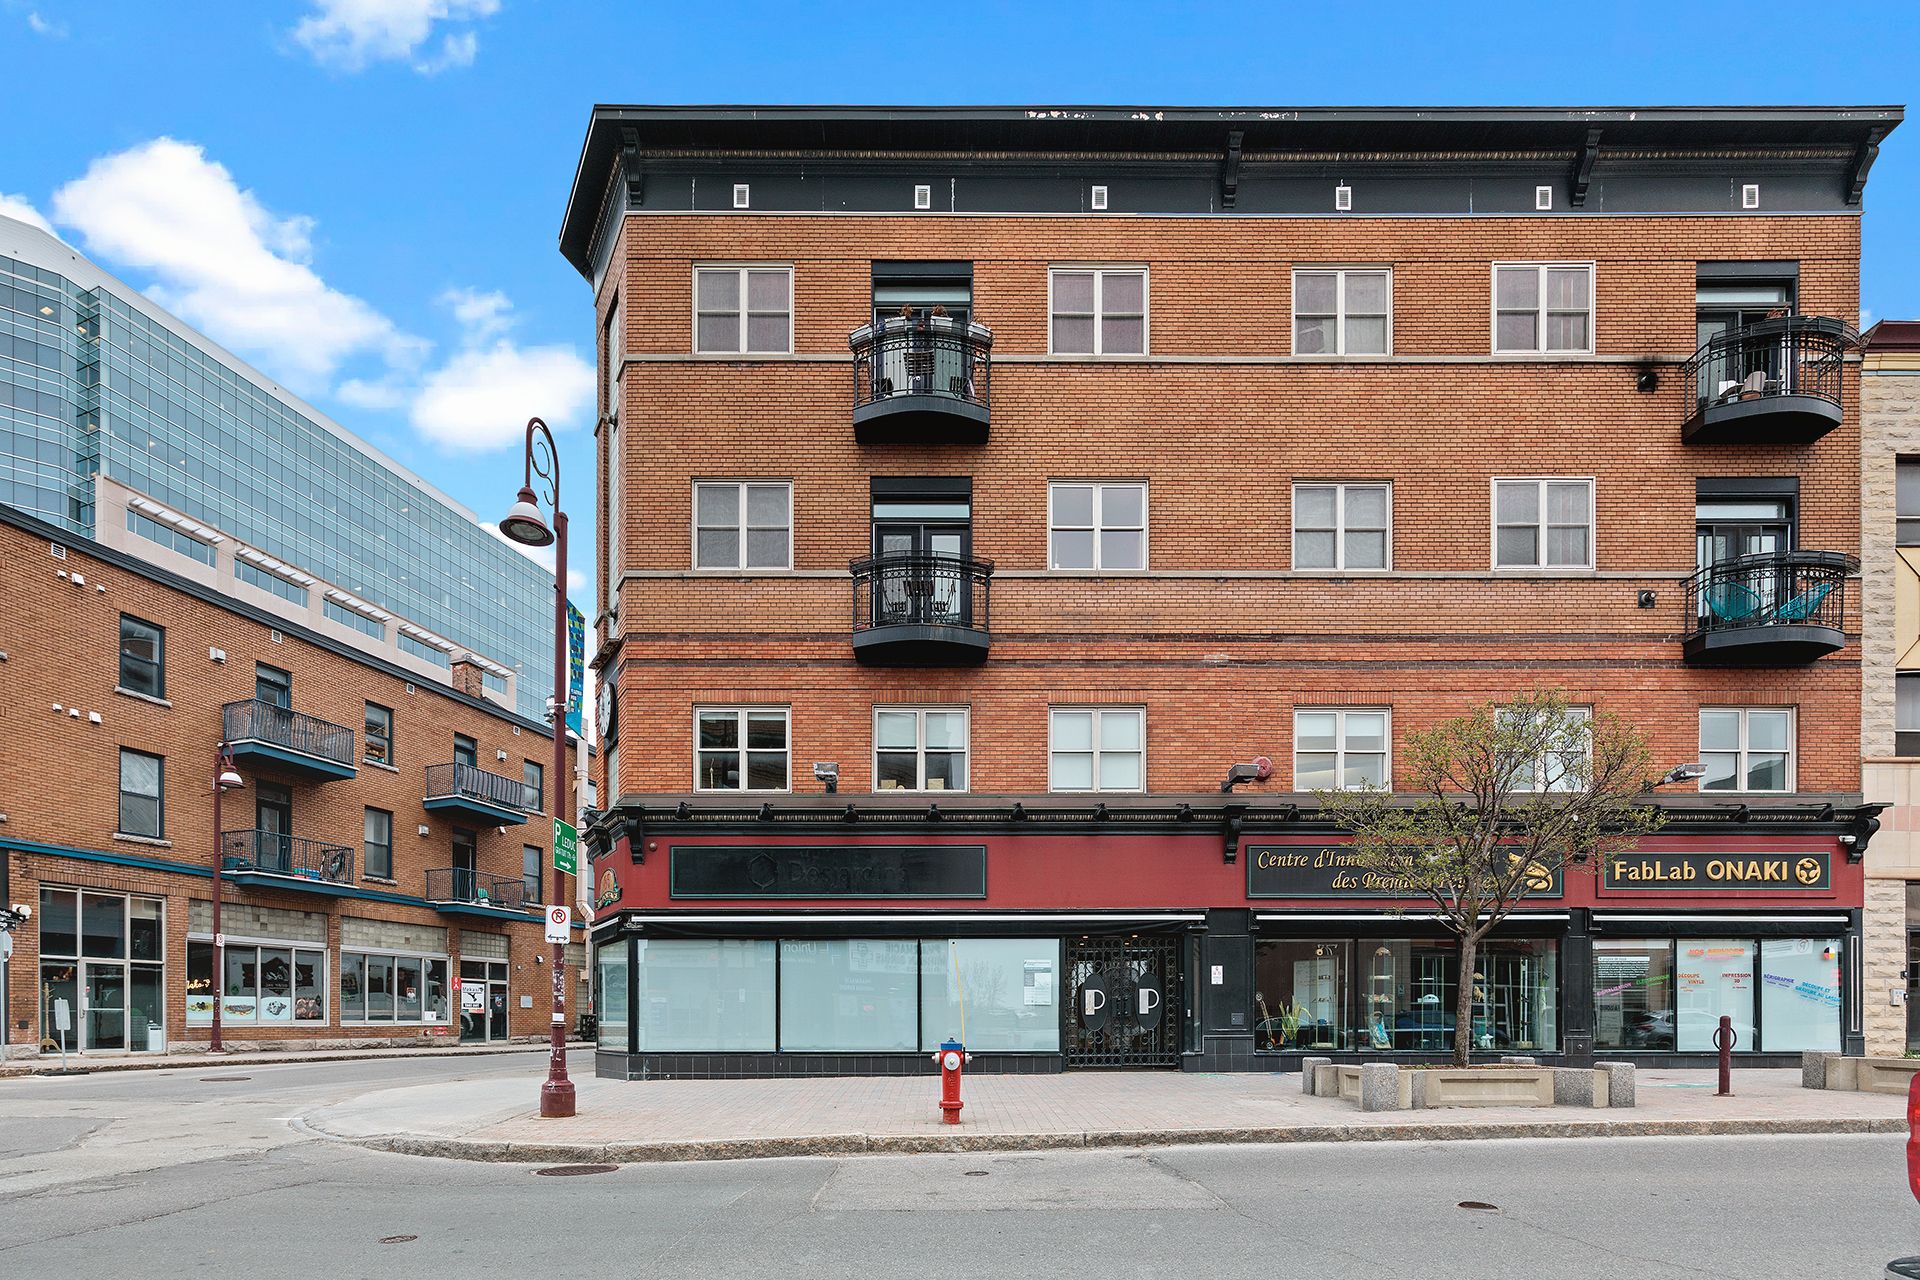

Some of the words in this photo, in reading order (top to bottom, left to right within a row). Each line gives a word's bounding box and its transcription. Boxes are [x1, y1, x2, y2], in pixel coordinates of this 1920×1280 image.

[555, 823, 561, 844] P
[1258, 850, 1309, 869] Centre
[1313, 848, 1414, 869] d'Innoin
[1332, 870, 1359, 889] des
[1362, 871, 1434, 890] Premi
[1614, 860, 1697, 881] FabLab
[1706, 860, 1788, 881] ONAKI
[1139, 988, 1160, 1014] P
